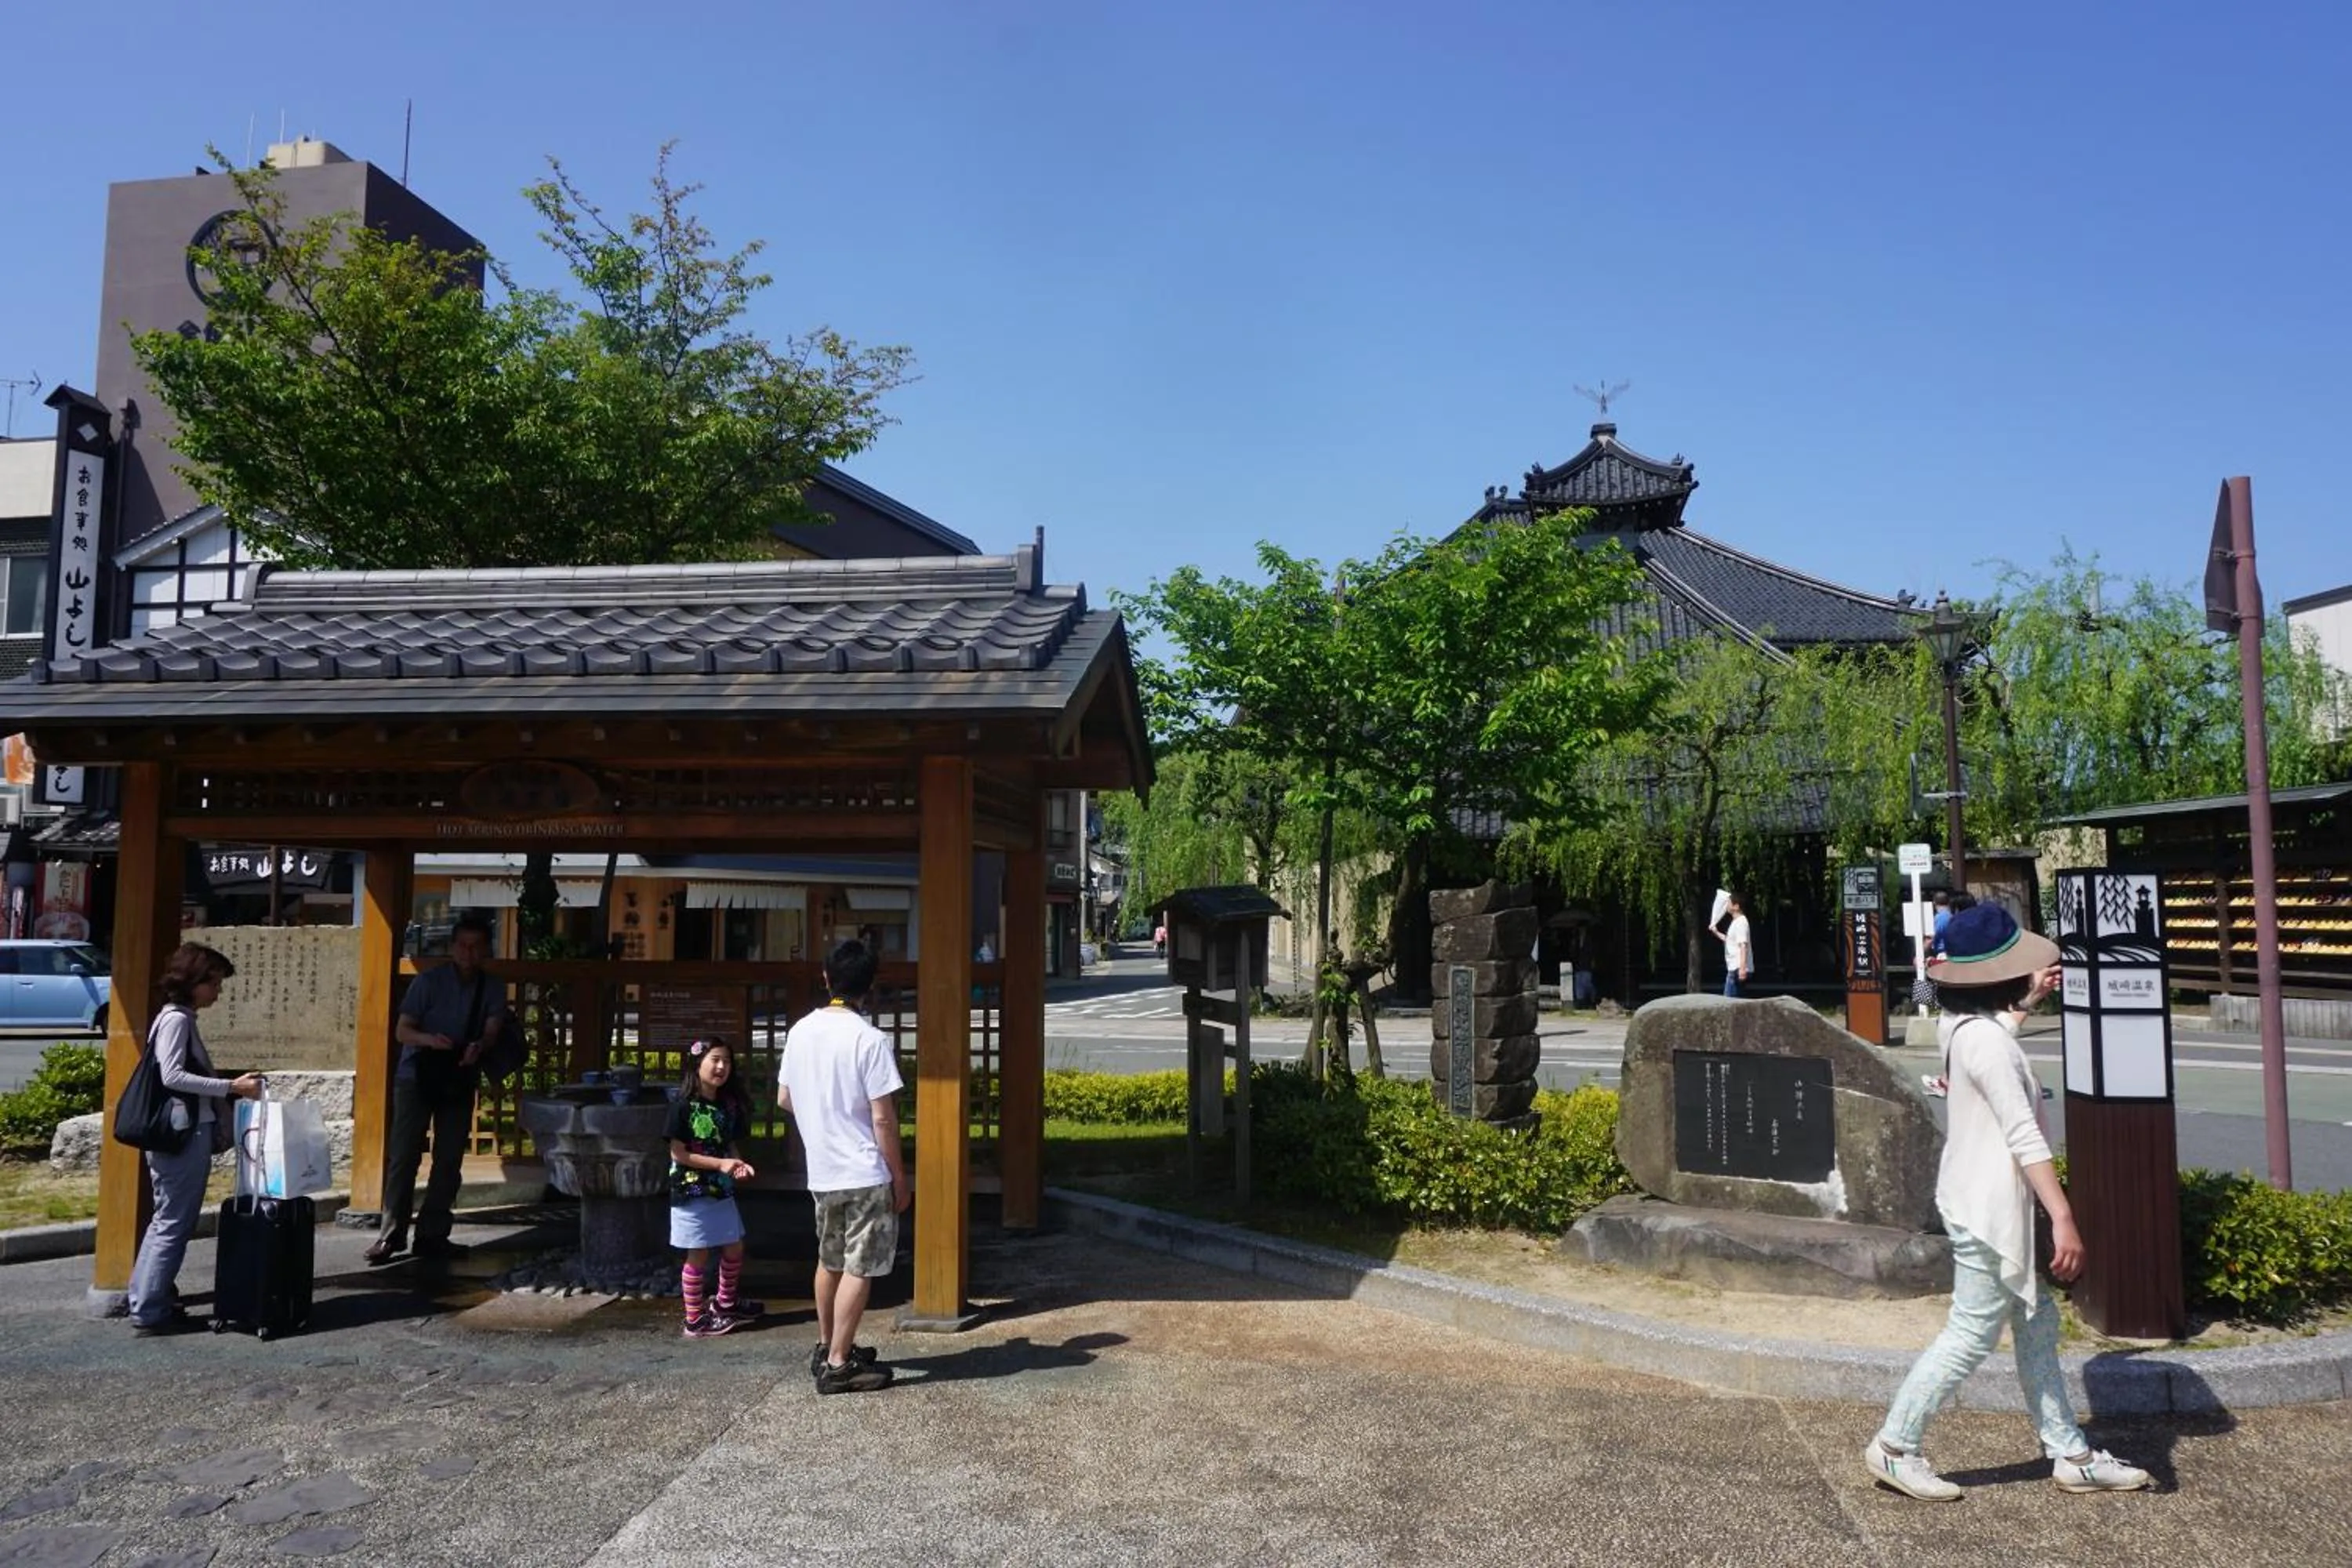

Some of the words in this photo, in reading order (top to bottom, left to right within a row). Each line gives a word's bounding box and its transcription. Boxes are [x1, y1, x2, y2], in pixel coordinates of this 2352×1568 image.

[72, 464, 92, 553] お食事処
[65, 564, 91, 648] 山よし
[583, 823, 626, 836] WATER
[256, 850, 318, 878] 山よし
[2107, 978, 2154, 992] 城崎温泉
